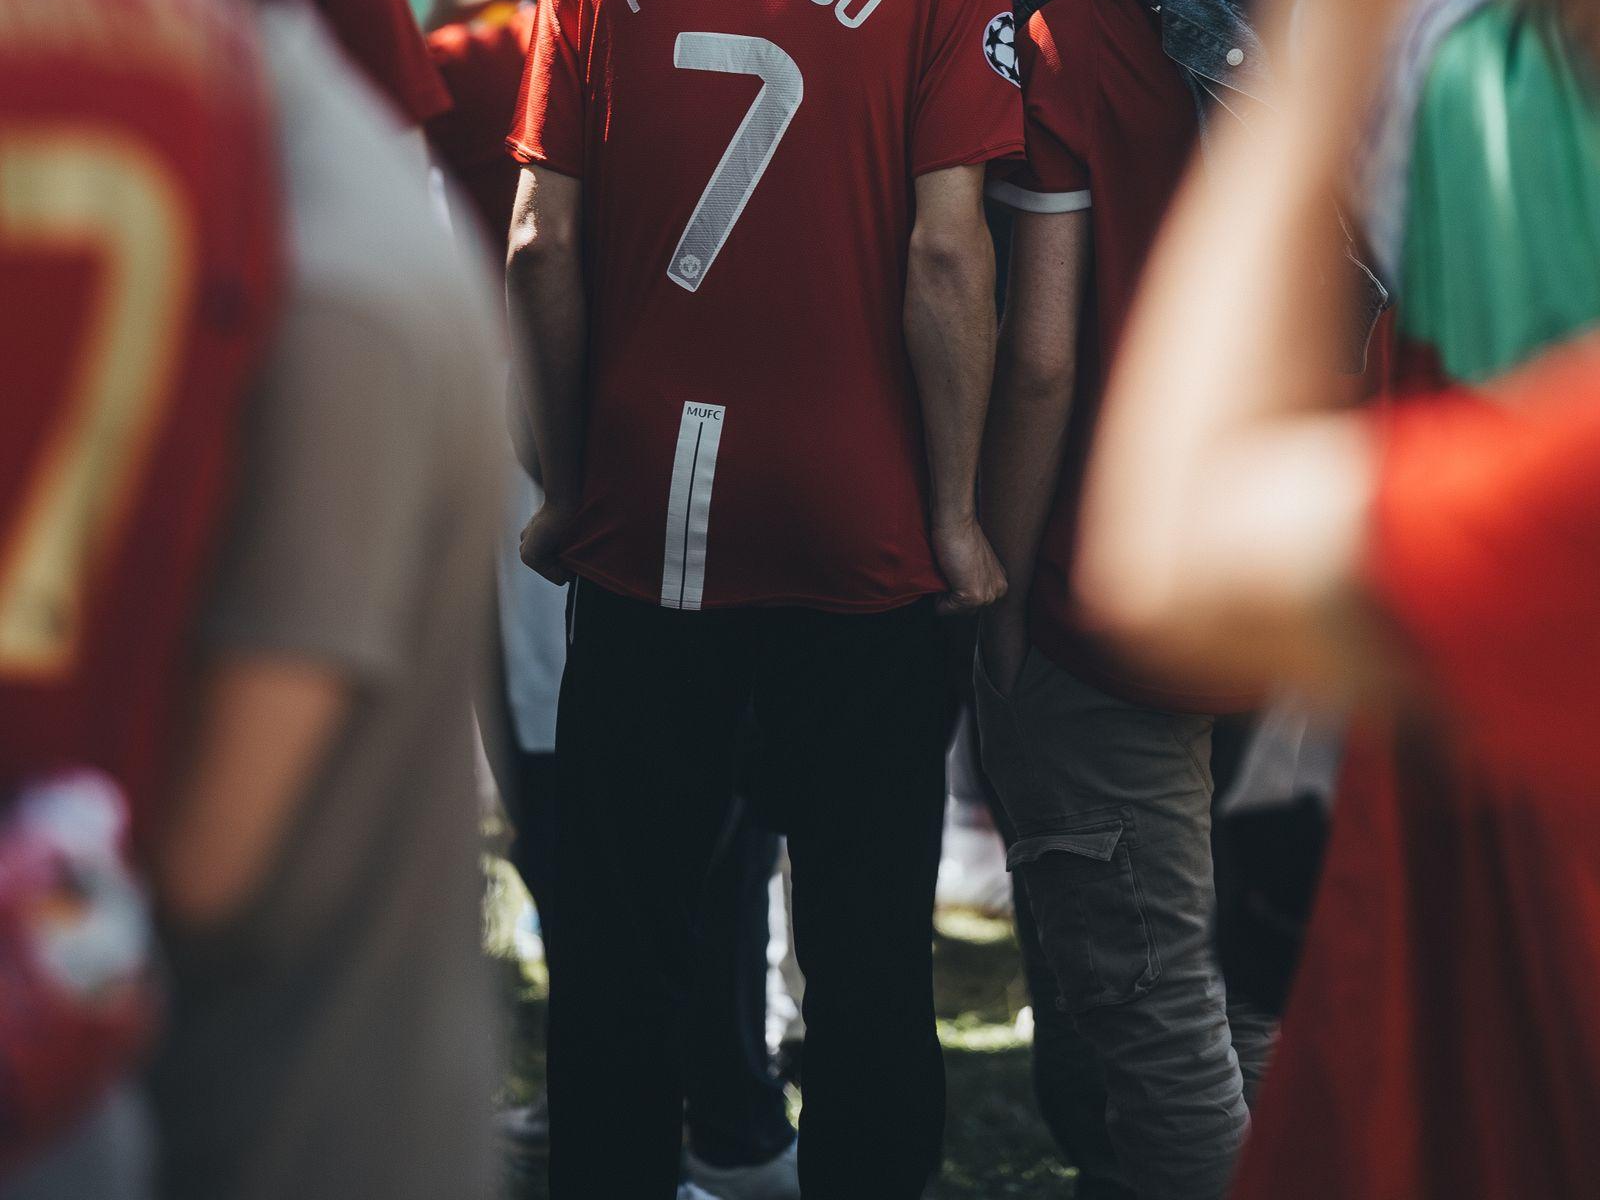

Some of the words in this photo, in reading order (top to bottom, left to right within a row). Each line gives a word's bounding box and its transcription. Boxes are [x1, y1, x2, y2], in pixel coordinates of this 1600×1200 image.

[667, 32, 804, 293] 7
[0, 132, 190, 678] 7
[686, 406, 722, 421] MUFC
